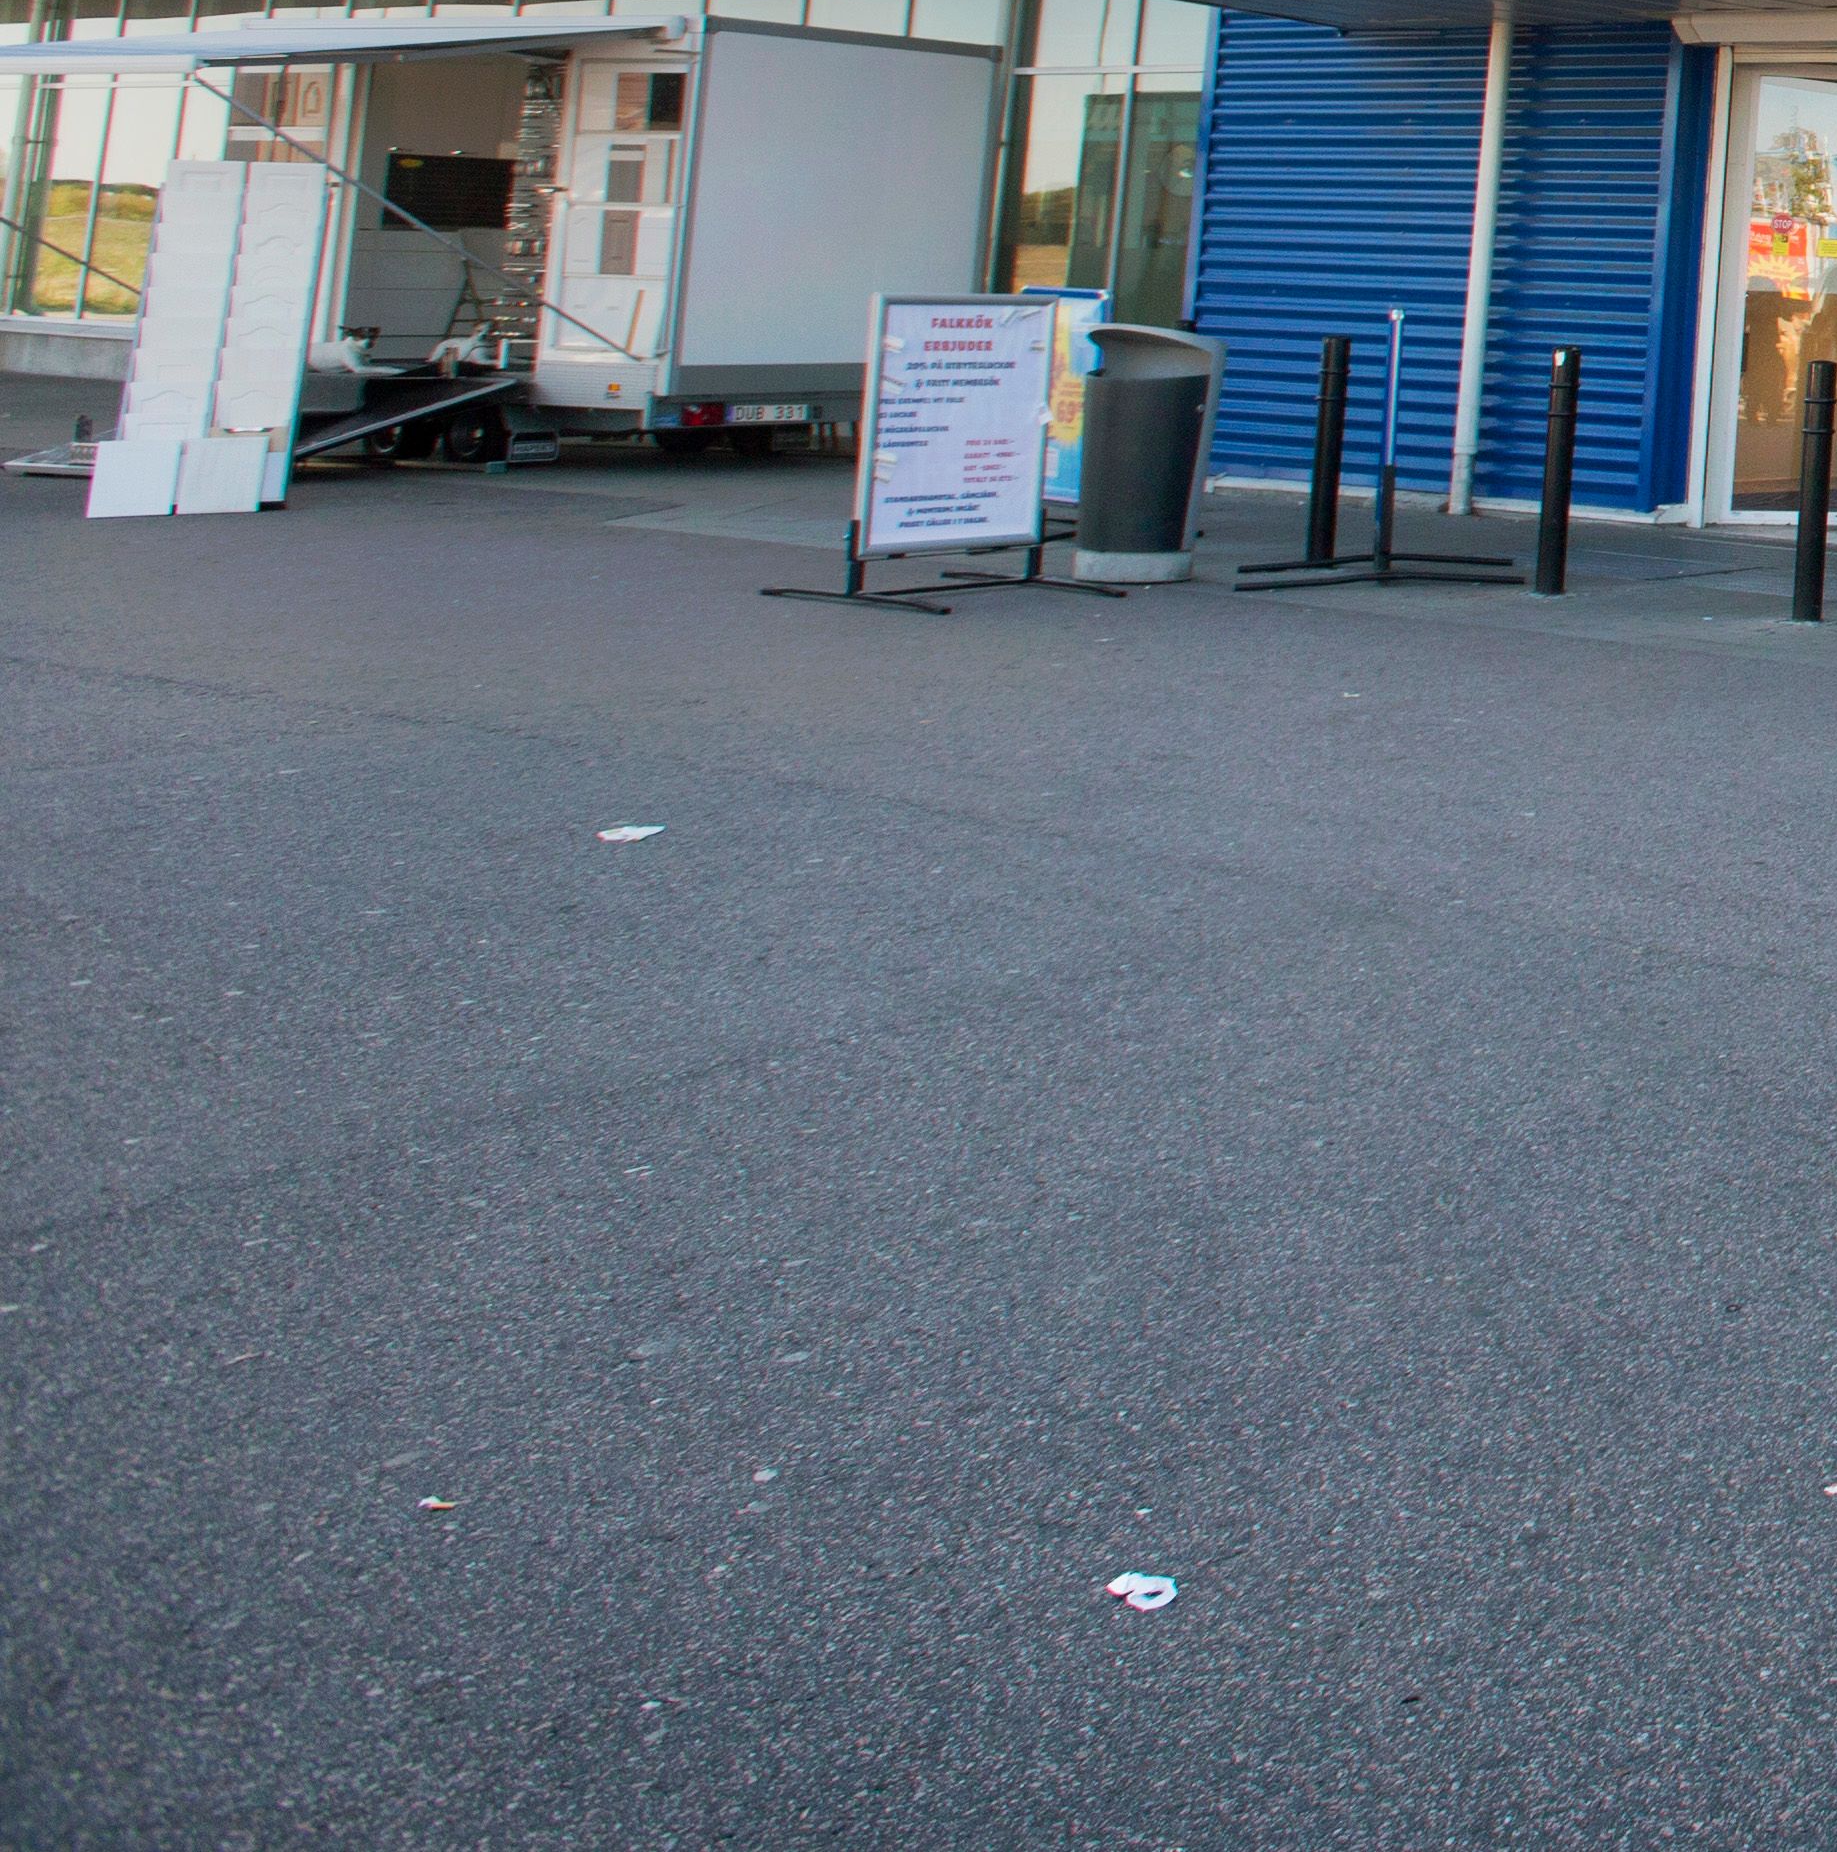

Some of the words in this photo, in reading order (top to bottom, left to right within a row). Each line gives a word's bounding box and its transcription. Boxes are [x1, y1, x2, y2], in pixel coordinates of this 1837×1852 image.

[1774, 220, 1793, 230] STOP
[924, 340, 994, 352] ERBJUDER
[734, 405, 764, 422] DUB
